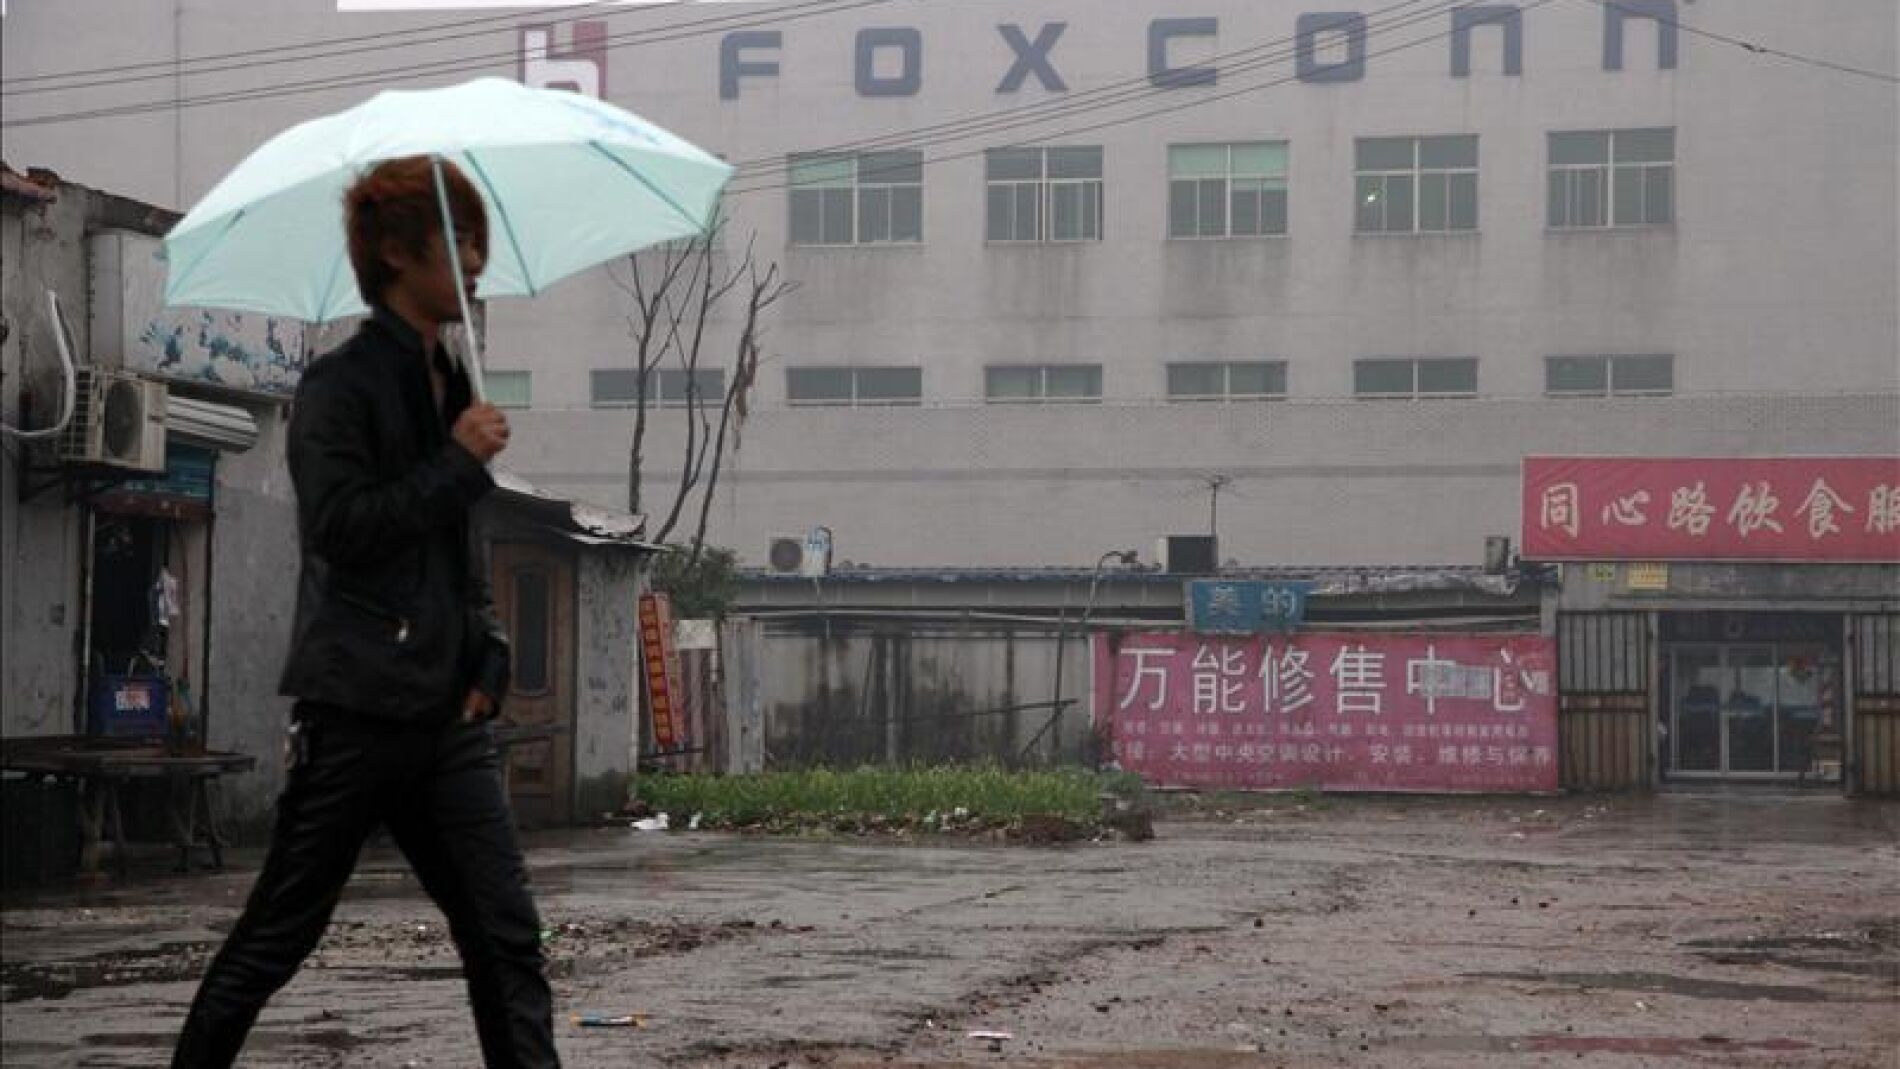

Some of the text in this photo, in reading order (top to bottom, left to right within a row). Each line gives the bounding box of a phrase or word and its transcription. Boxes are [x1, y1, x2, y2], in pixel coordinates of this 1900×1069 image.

[1541, 478, 1900, 538] 同心路饮食服
[1119, 643, 1534, 714] 万能修售中心
